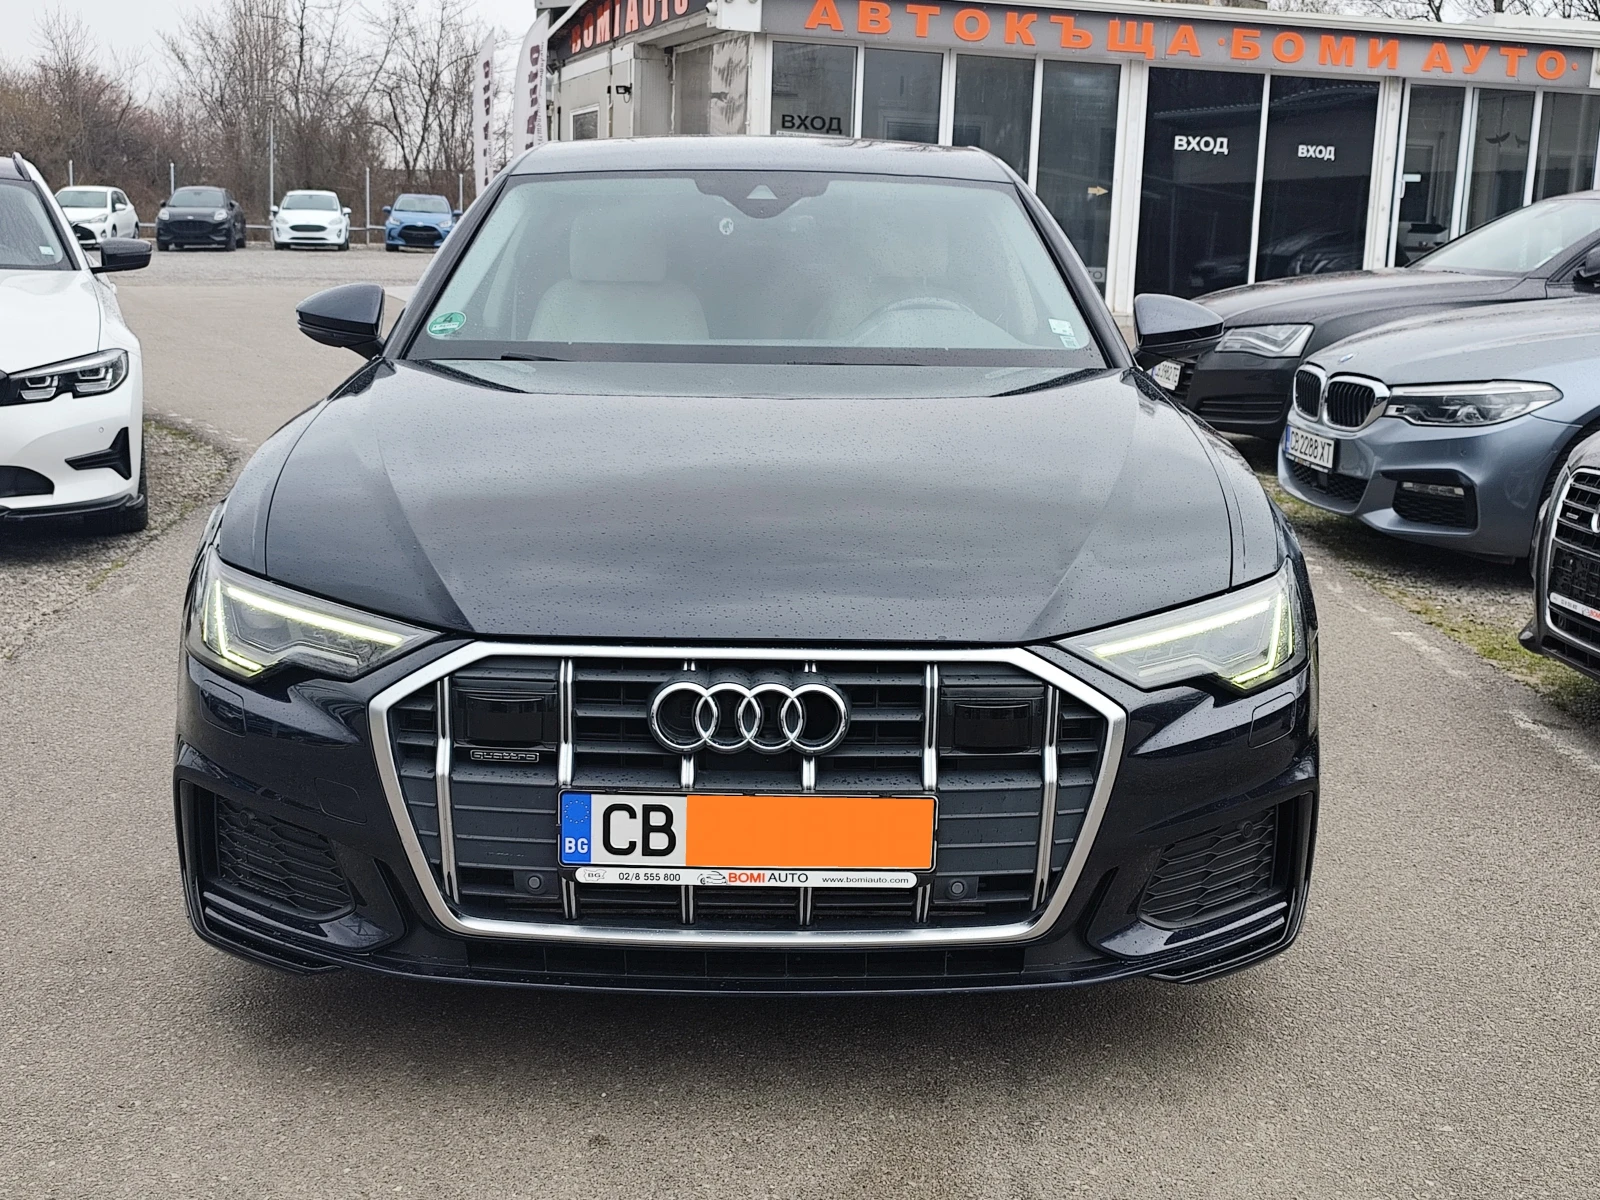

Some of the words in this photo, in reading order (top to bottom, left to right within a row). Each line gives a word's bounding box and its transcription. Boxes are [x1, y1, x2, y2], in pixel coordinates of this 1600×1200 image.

[804, 0, 1202, 60] АВТОКЪЩА
[1230, 27, 1399, 70] БОМИ
[1421, 42, 1567, 81] АУТО
[781, 114, 843, 135] ВХОД
[1174, 135, 1229, 156] ВХОД
[1297, 144, 1336, 161] ВХОД
[1299, 434, 1319, 459] 2288
[1319, 440, 1332, 464] XT
[473, 752, 536, 761] quattro
[602, 803, 677, 856] CB
[564, 837, 588, 854] BG
[618, 871, 641, 882] 02/8
[643, 872, 661, 882] 555
[663, 873, 681, 882] 800
[728, 872, 766, 884] BOMI
[767, 872, 809, 884] AUTO
[821, 875, 909, 885] www.bomiauto.com
